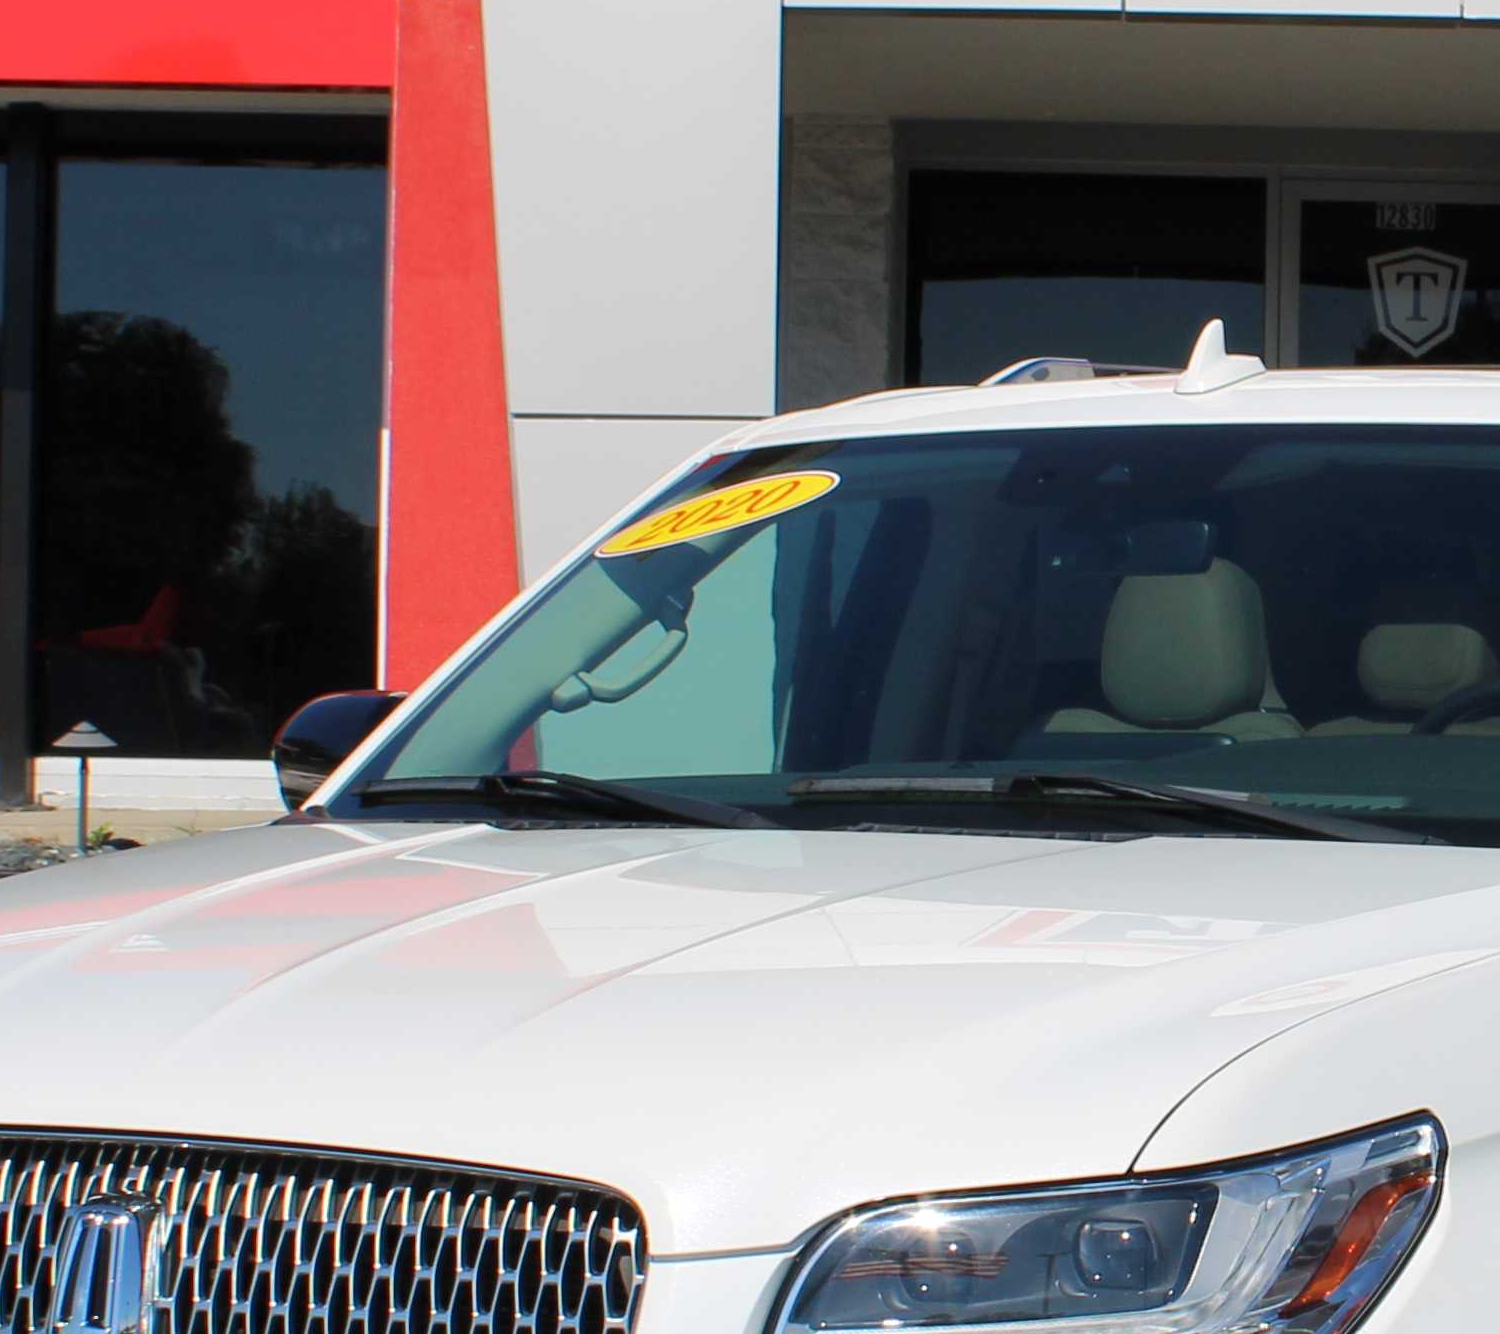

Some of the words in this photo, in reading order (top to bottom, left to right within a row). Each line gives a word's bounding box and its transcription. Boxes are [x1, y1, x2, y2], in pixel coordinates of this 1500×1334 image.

[1377, 203, 1435, 229] 12830
[1396, 271, 1439, 322] T
[627, 480, 801, 547] 2020
